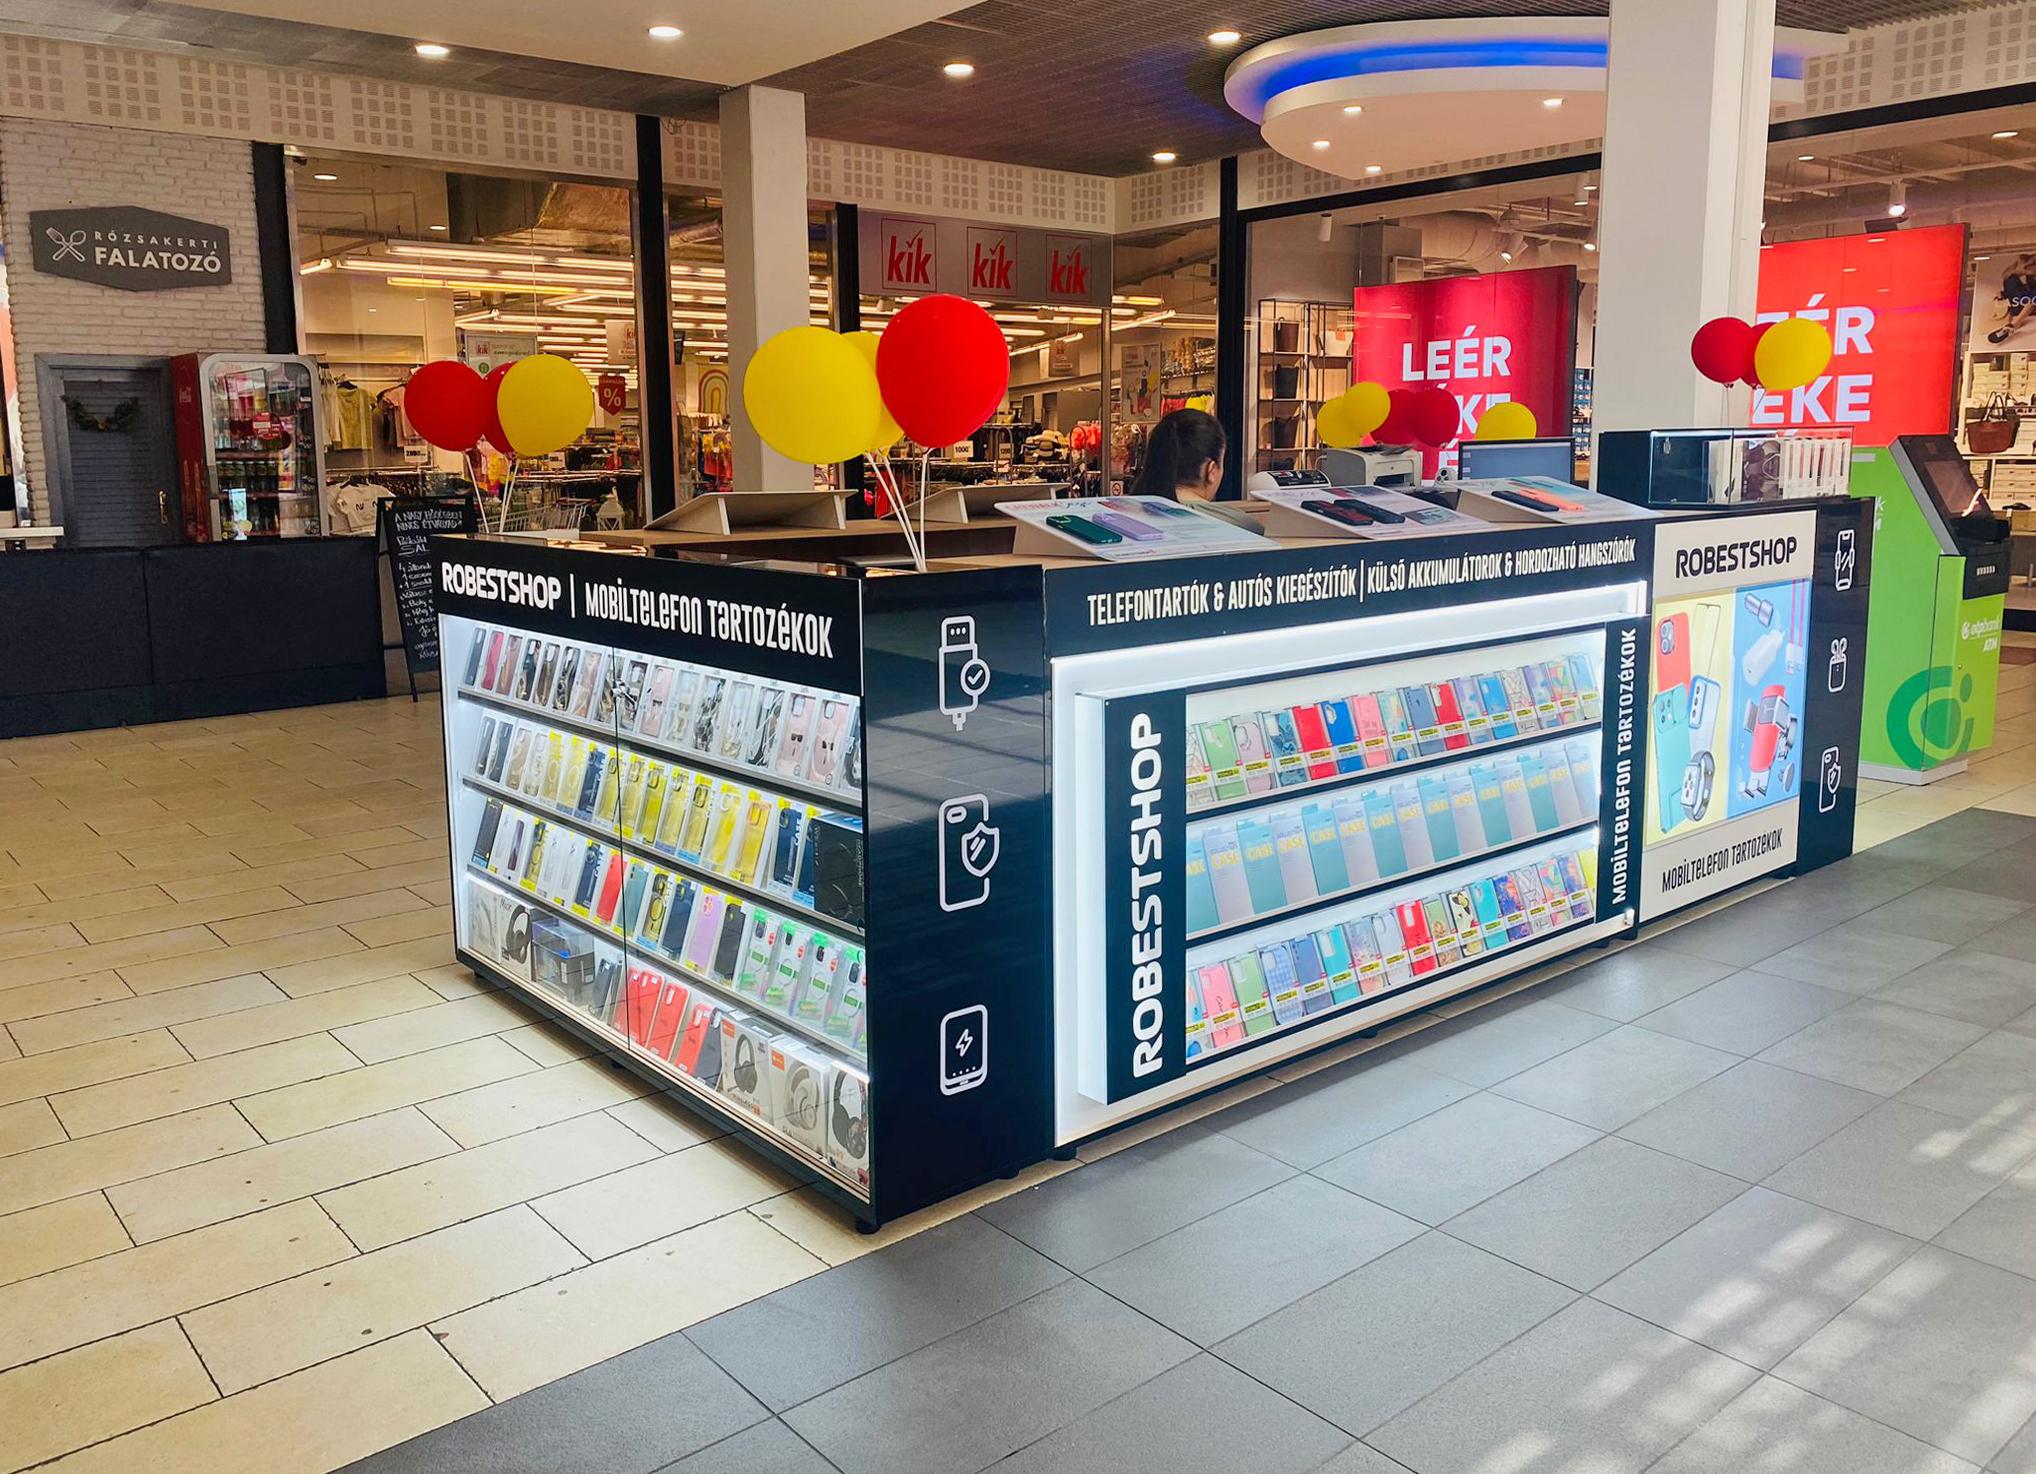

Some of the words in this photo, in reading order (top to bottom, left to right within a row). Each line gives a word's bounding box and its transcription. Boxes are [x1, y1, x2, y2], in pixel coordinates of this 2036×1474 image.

[95, 230, 218, 250] RÓZSAKERTI
[95, 246, 222, 274] FALATOZÓ
[887, 229, 932, 284] kik
[972, 236, 1014, 290] kik
[1050, 244, 1088, 295] kik
[1402, 325, 1512, 382] LEÉR
[1087, 578, 1208, 626] TELEFONTARTÓK
[1213, 583, 1225, 609] &
[1228, 574, 1273, 609] AUTÓS
[1276, 564, 1356, 605] KIEGÉSZÍTŐK
[1367, 562, 1405, 596] KÜLSŐ
[1408, 550, 1502, 589] AKKUMULÁTOROK
[1504, 552, 1512, 578] &
[1514, 540, 1576, 576] HORDOZHATÓ
[1578, 534, 1636, 568] HANGSZÓRÓK
[1675, 536, 1798, 578] ROBESTSHOP
[442, 562, 562, 611] ROBESTSHOP
[1130, 712, 1163, 1078] ROBESTSHOP
